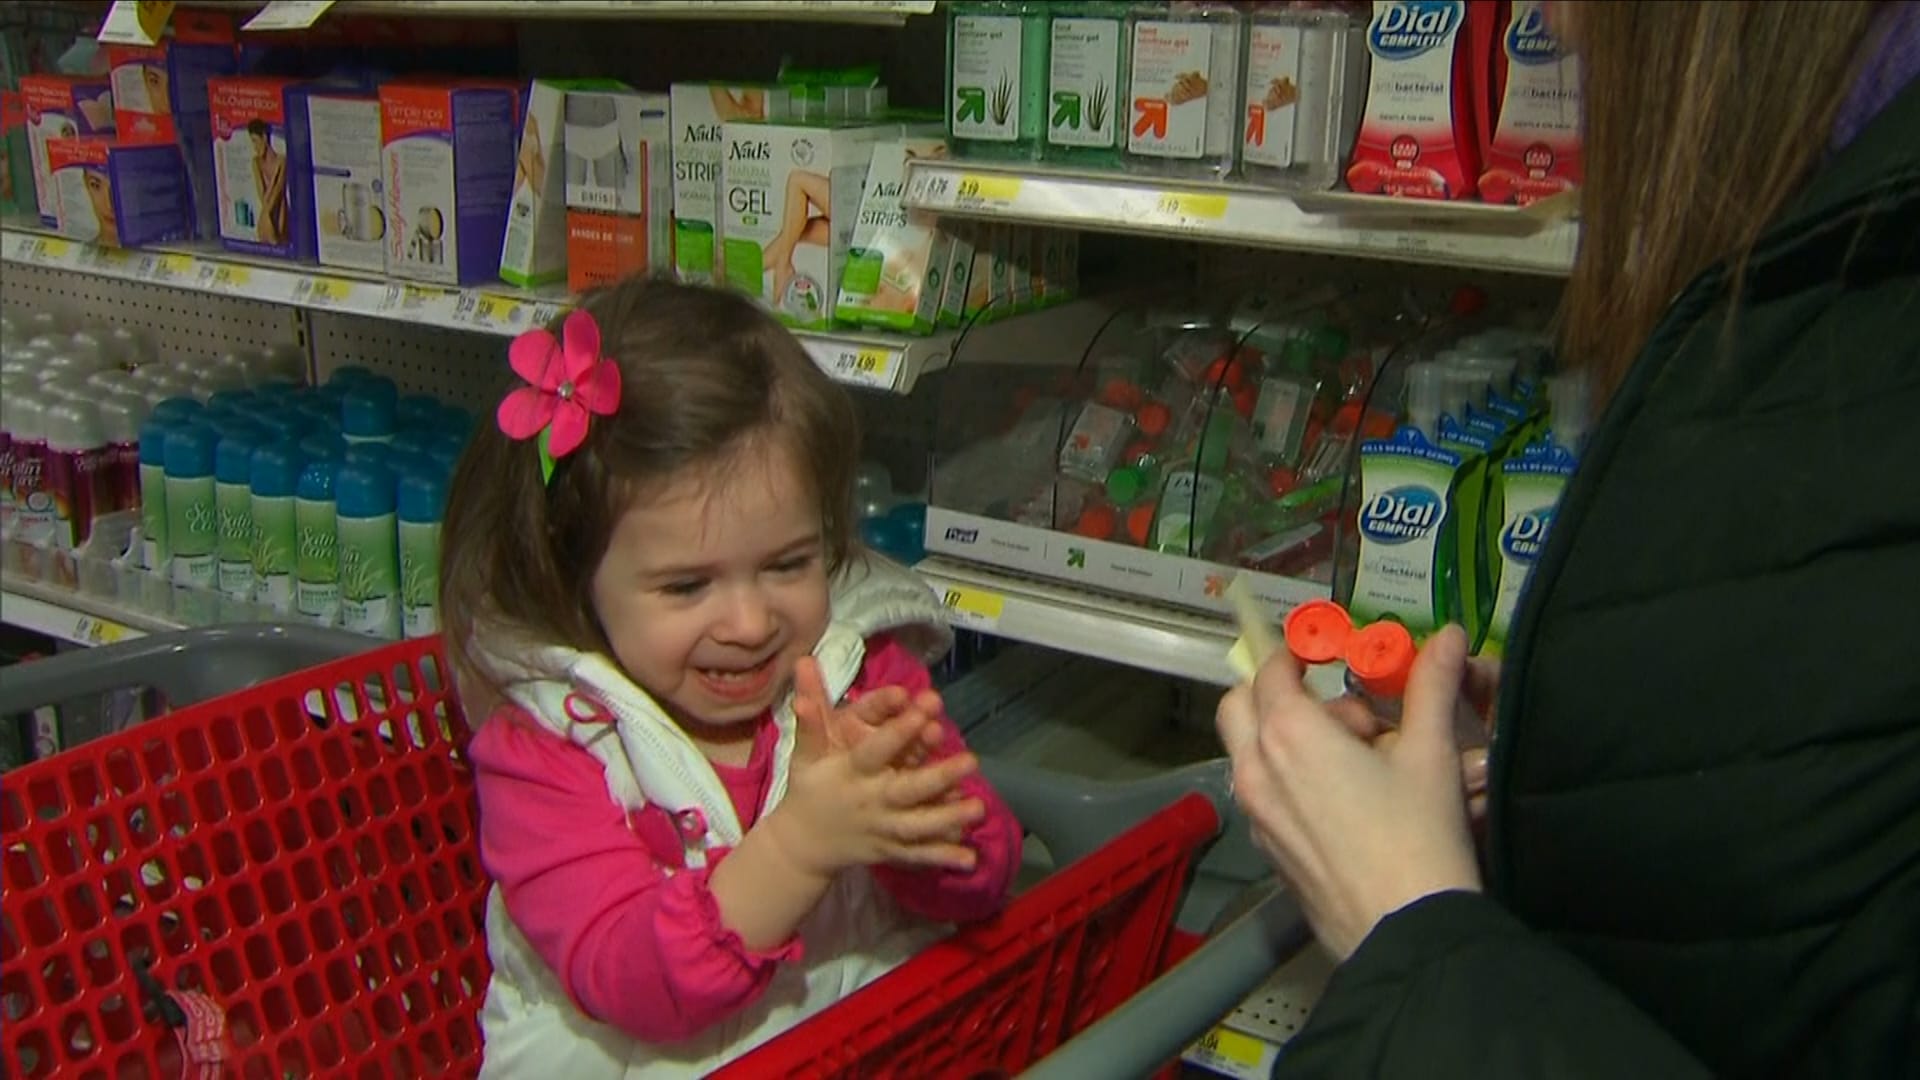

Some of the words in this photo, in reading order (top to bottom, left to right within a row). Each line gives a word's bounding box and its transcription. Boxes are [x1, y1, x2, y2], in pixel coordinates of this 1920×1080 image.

[1380, 4, 1451, 34] Dial
[1380, 33, 1445, 49] COMPLETE
[729, 140, 771, 161] Nad's
[675, 160, 722, 182] STRIP
[729, 187, 773, 216] GEL
[860, 211, 908, 228] STRIPS
[1367, 492, 1437, 526] Dial
[1367, 520, 1428, 540] COMPLETE
[1511, 512, 1551, 541] Di
